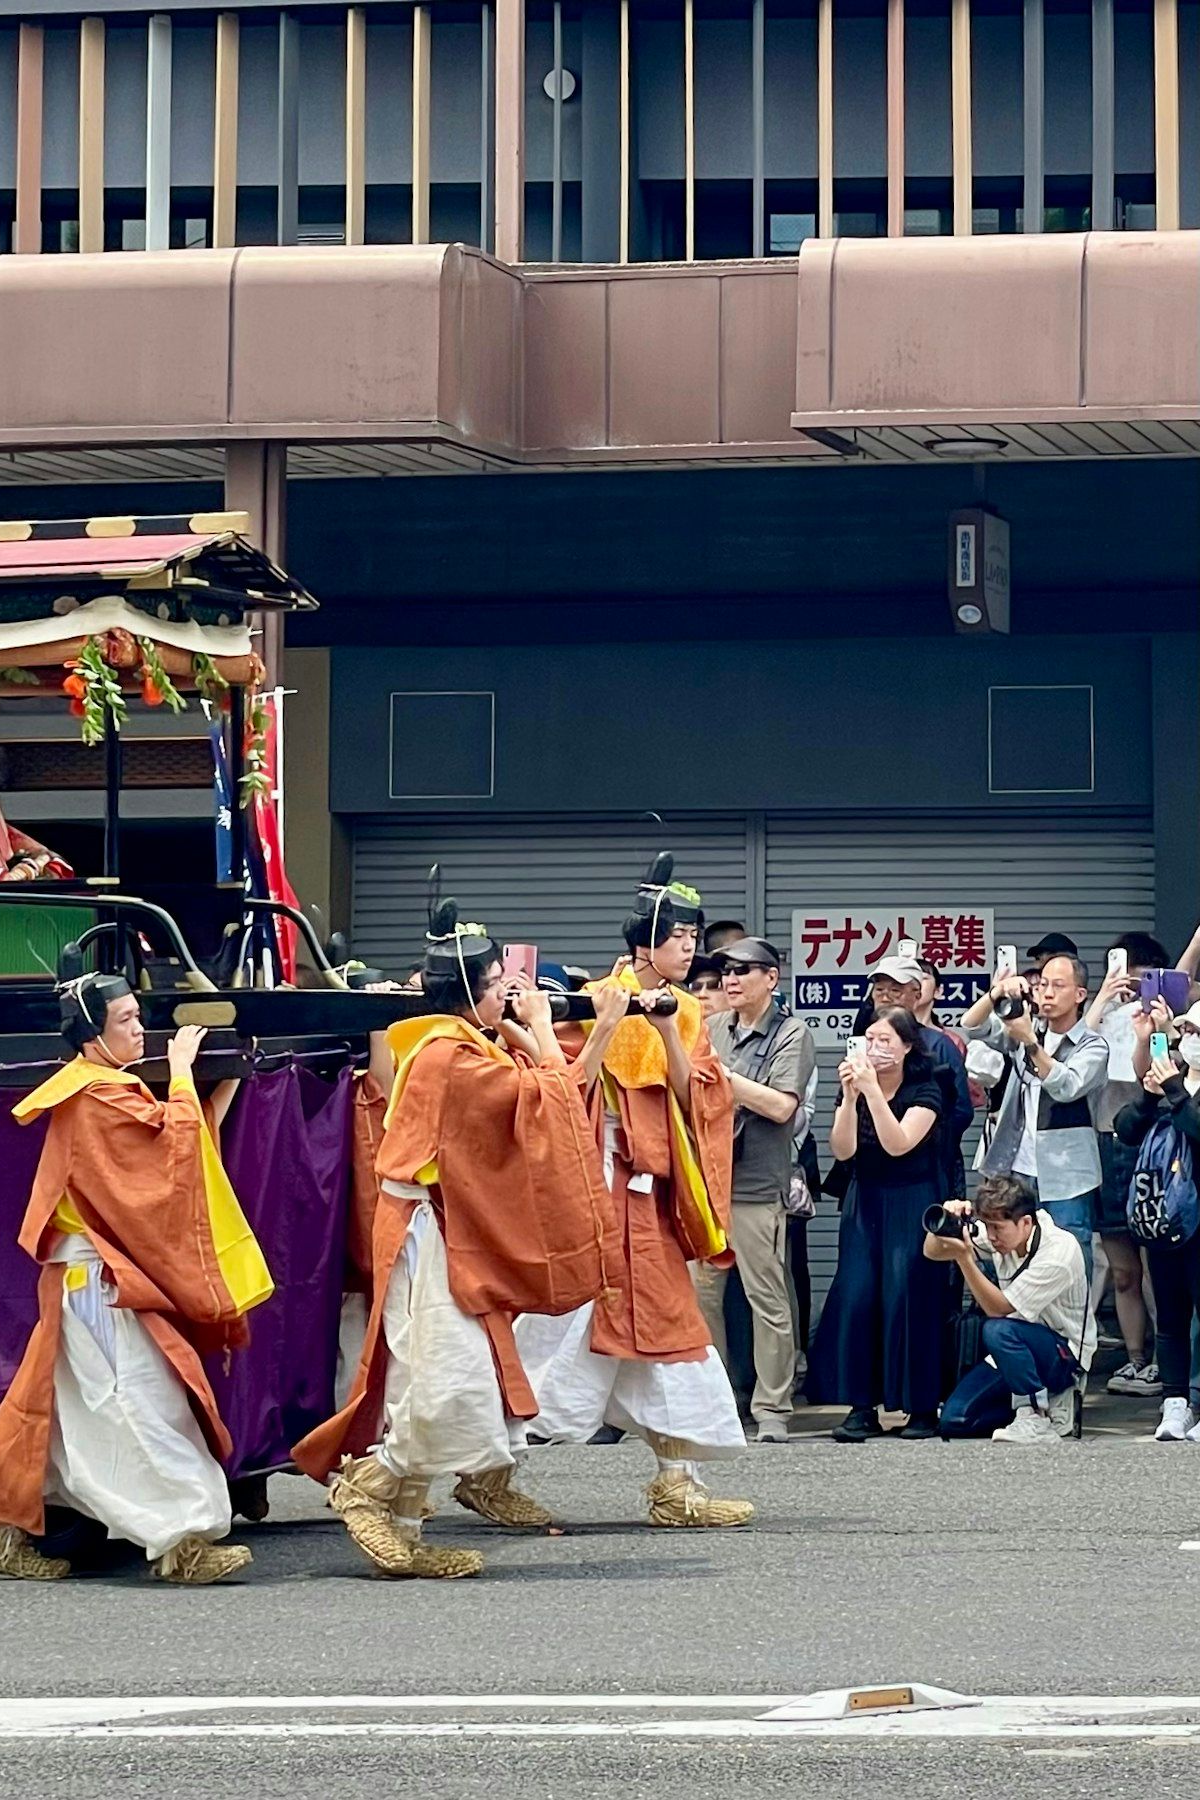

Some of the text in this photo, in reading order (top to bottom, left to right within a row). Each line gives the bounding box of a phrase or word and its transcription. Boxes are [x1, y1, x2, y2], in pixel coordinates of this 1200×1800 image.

[801, 914, 987, 969] テナント募集
